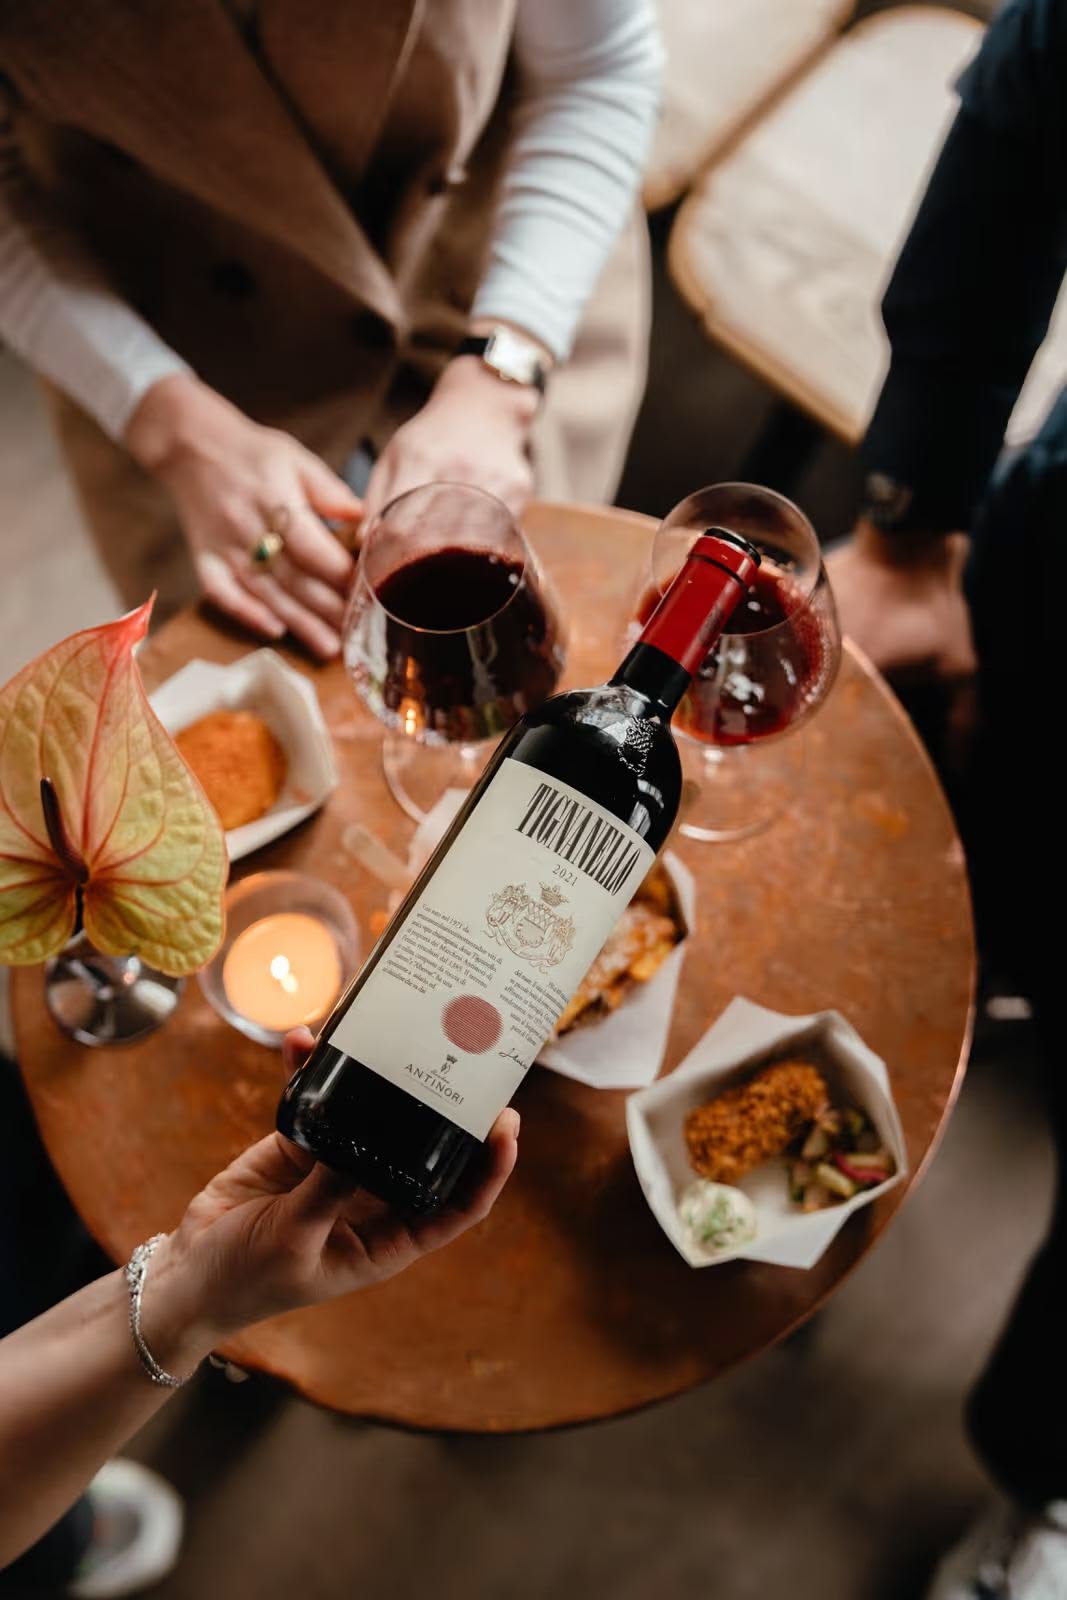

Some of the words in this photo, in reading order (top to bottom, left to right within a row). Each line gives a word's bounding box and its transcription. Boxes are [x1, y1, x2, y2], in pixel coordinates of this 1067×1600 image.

[515, 783, 640, 896] TIGNANELLO
[552, 864, 578, 887] 2021
[404, 1064, 464, 1105] ANTINORI
